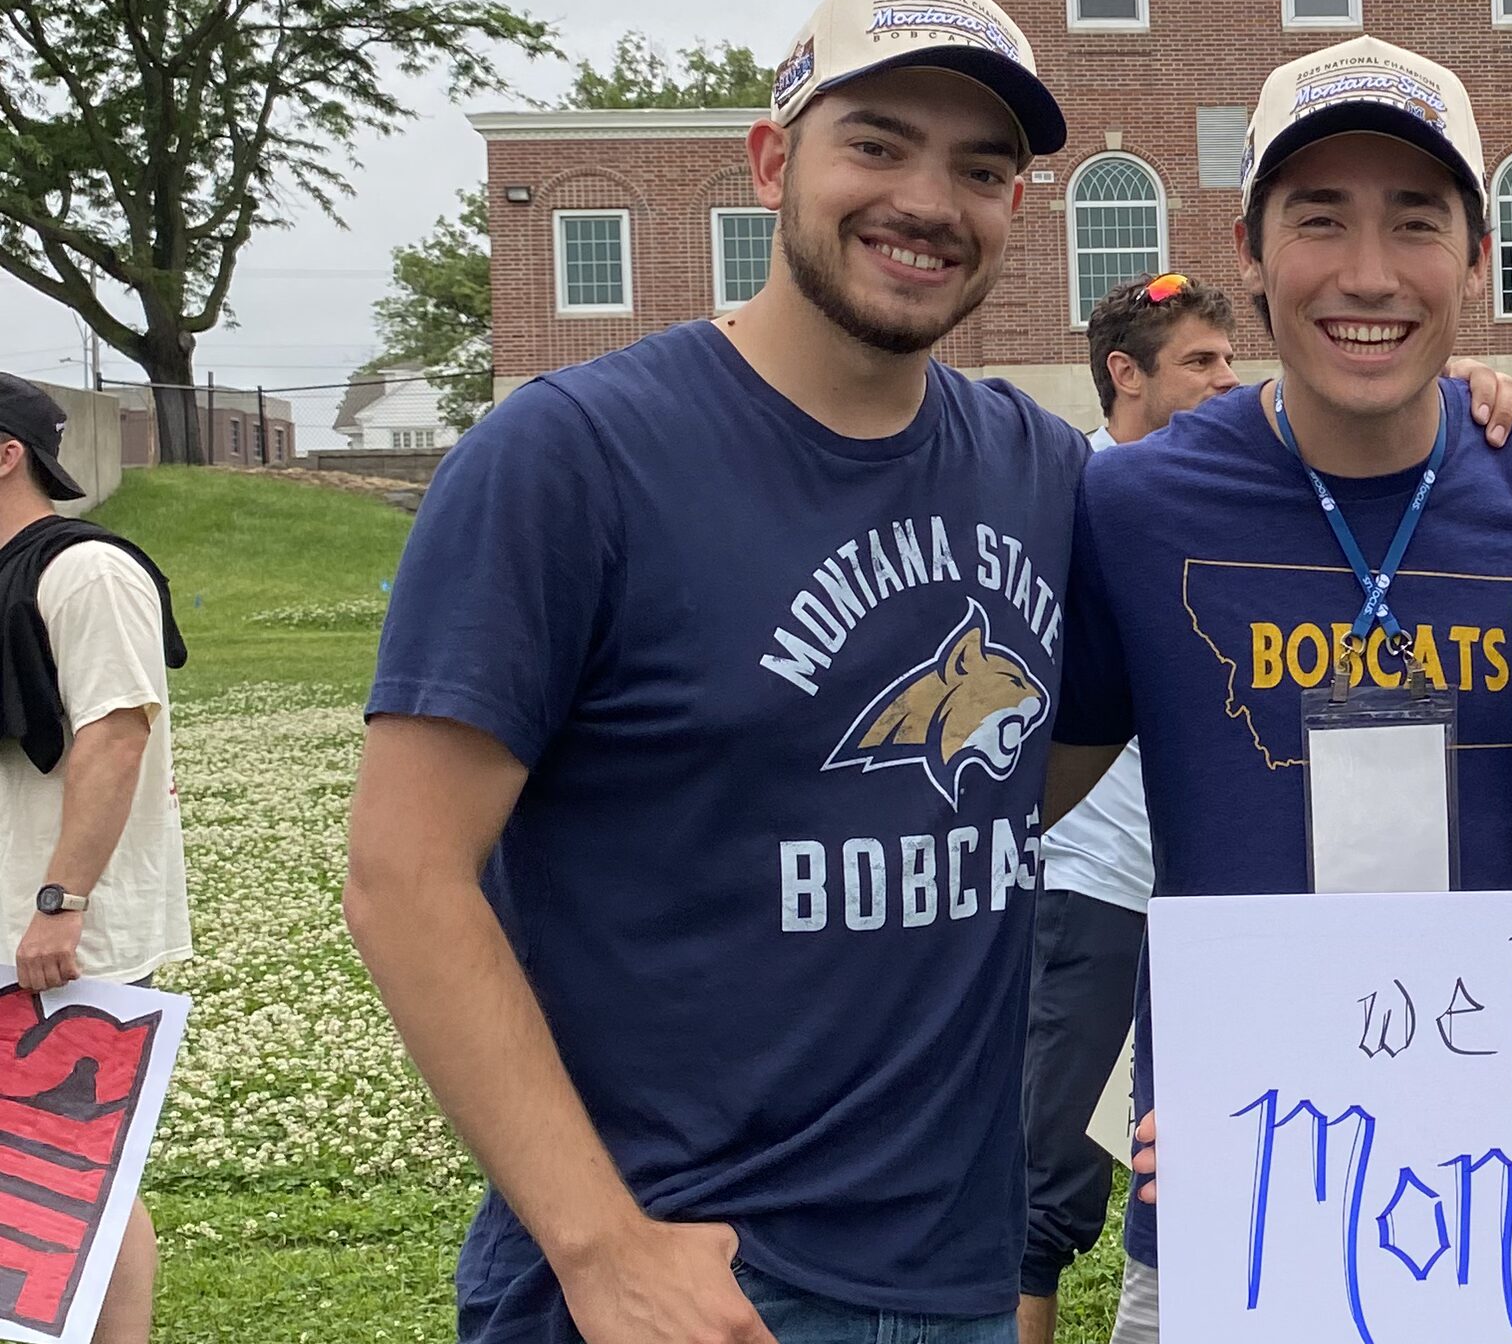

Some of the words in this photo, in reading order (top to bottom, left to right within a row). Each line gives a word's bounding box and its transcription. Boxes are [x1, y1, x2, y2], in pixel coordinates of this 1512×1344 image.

[866, 7, 984, 34] Montana
[873, 31, 971, 46] BOBCAT
[1296, 66, 1321, 80] 2025
[1325, 57, 1380, 70] NATIONAL
[1384, 60, 1441, 91] CHAMPIONS
[1290, 75, 1397, 115] Montana
[1397, 74, 1448, 113] State
[759, 515, 961, 697] MONTANA
[976, 524, 1062, 658] STATE
[1249, 622, 1511, 692] BOBCATS
